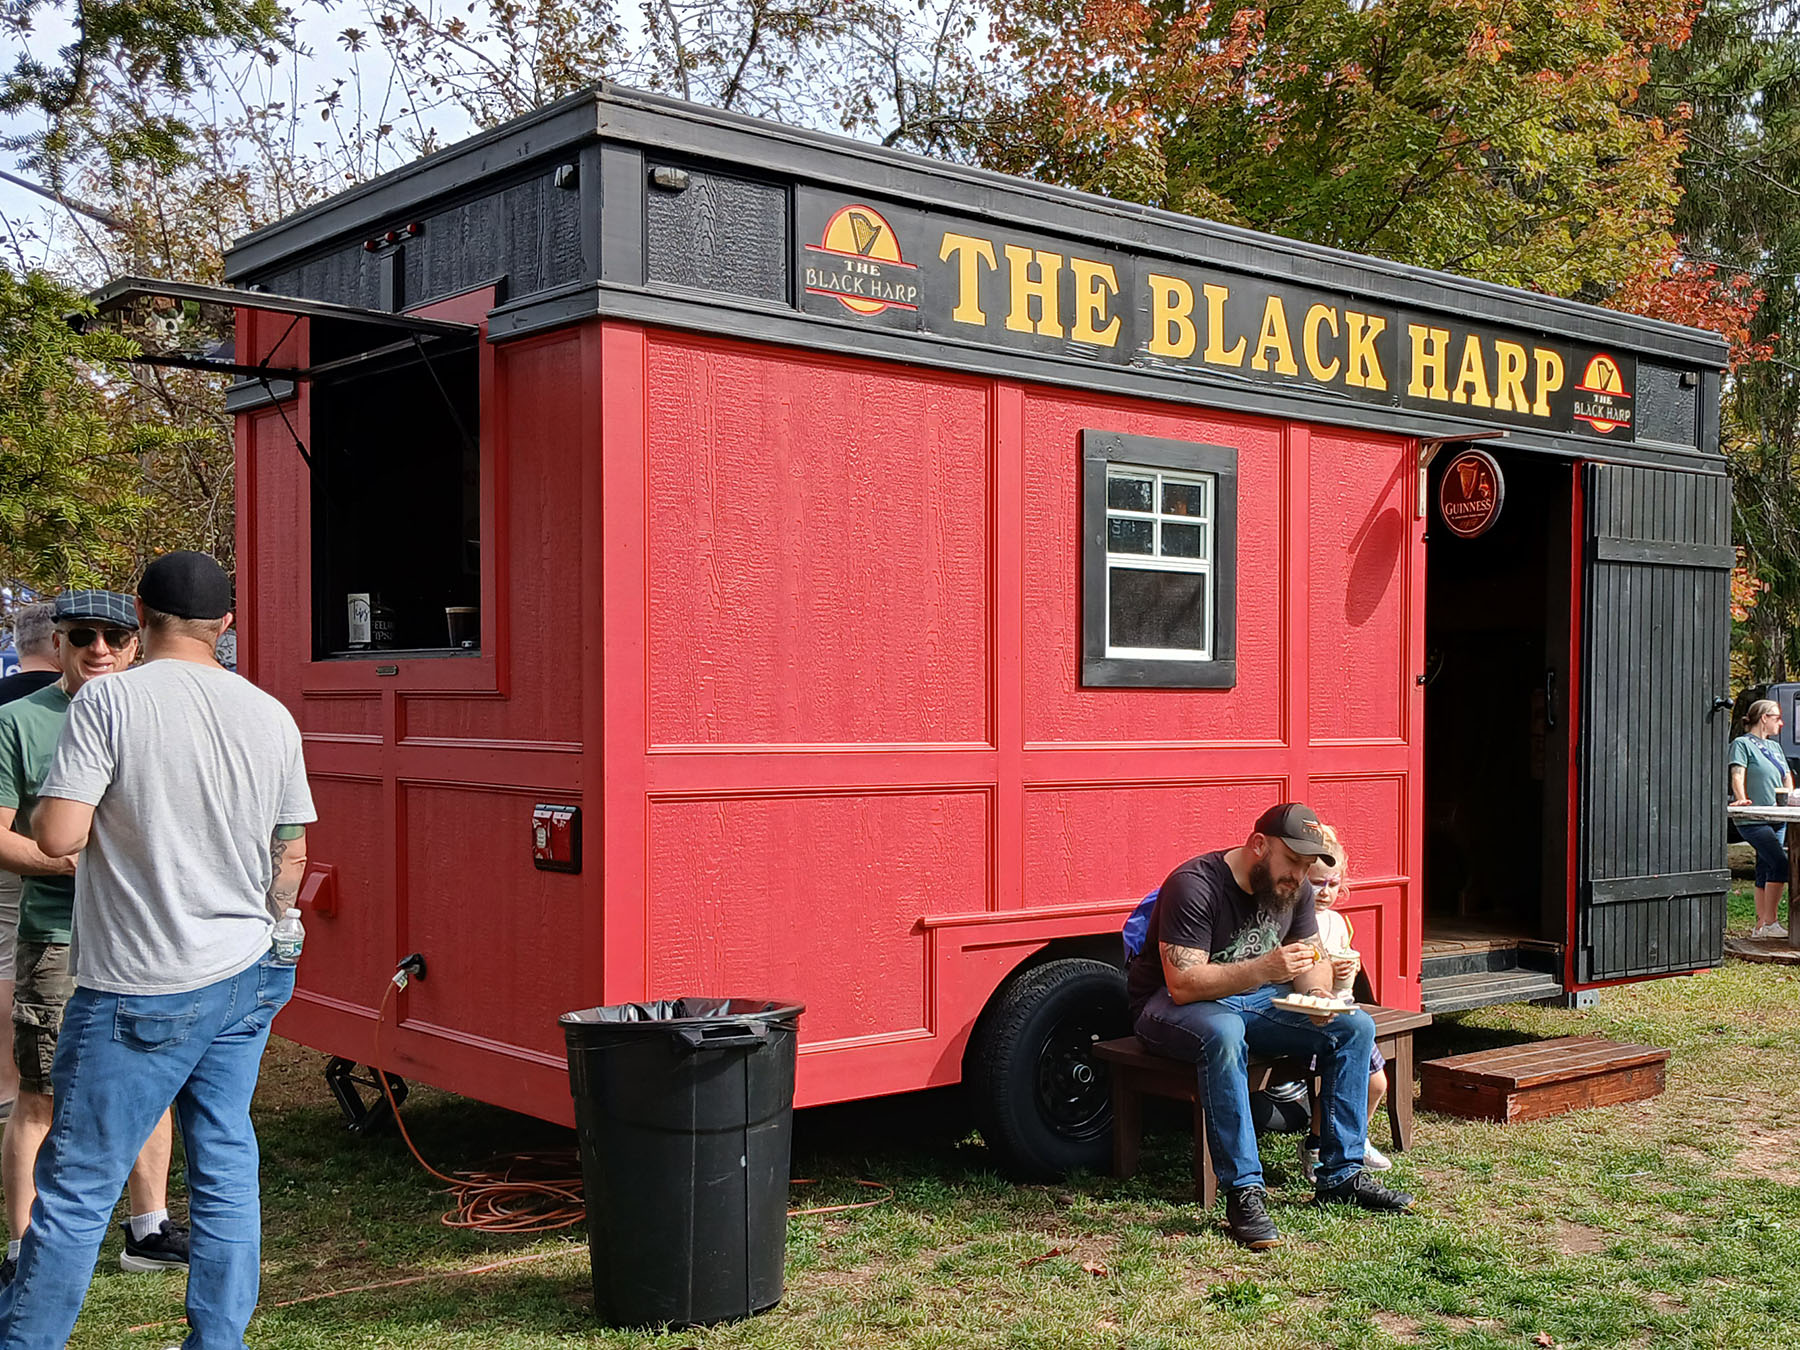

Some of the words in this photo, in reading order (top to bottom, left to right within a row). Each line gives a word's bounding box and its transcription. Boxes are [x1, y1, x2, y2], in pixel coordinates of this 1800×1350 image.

[843, 259, 881, 276] THE
[805, 267, 865, 294] BLACK
[871, 279, 918, 302] HARP
[938, 231, 1122, 348] THE
[1147, 273, 1388, 392] BLACK
[1408, 323, 1566, 417] HARP
[1593, 394, 1613, 405] THE
[1574, 401, 1604, 418] BLACK
[1606, 406, 1631, 422] HARP
[1445, 499, 1492, 516] GUINNESS
